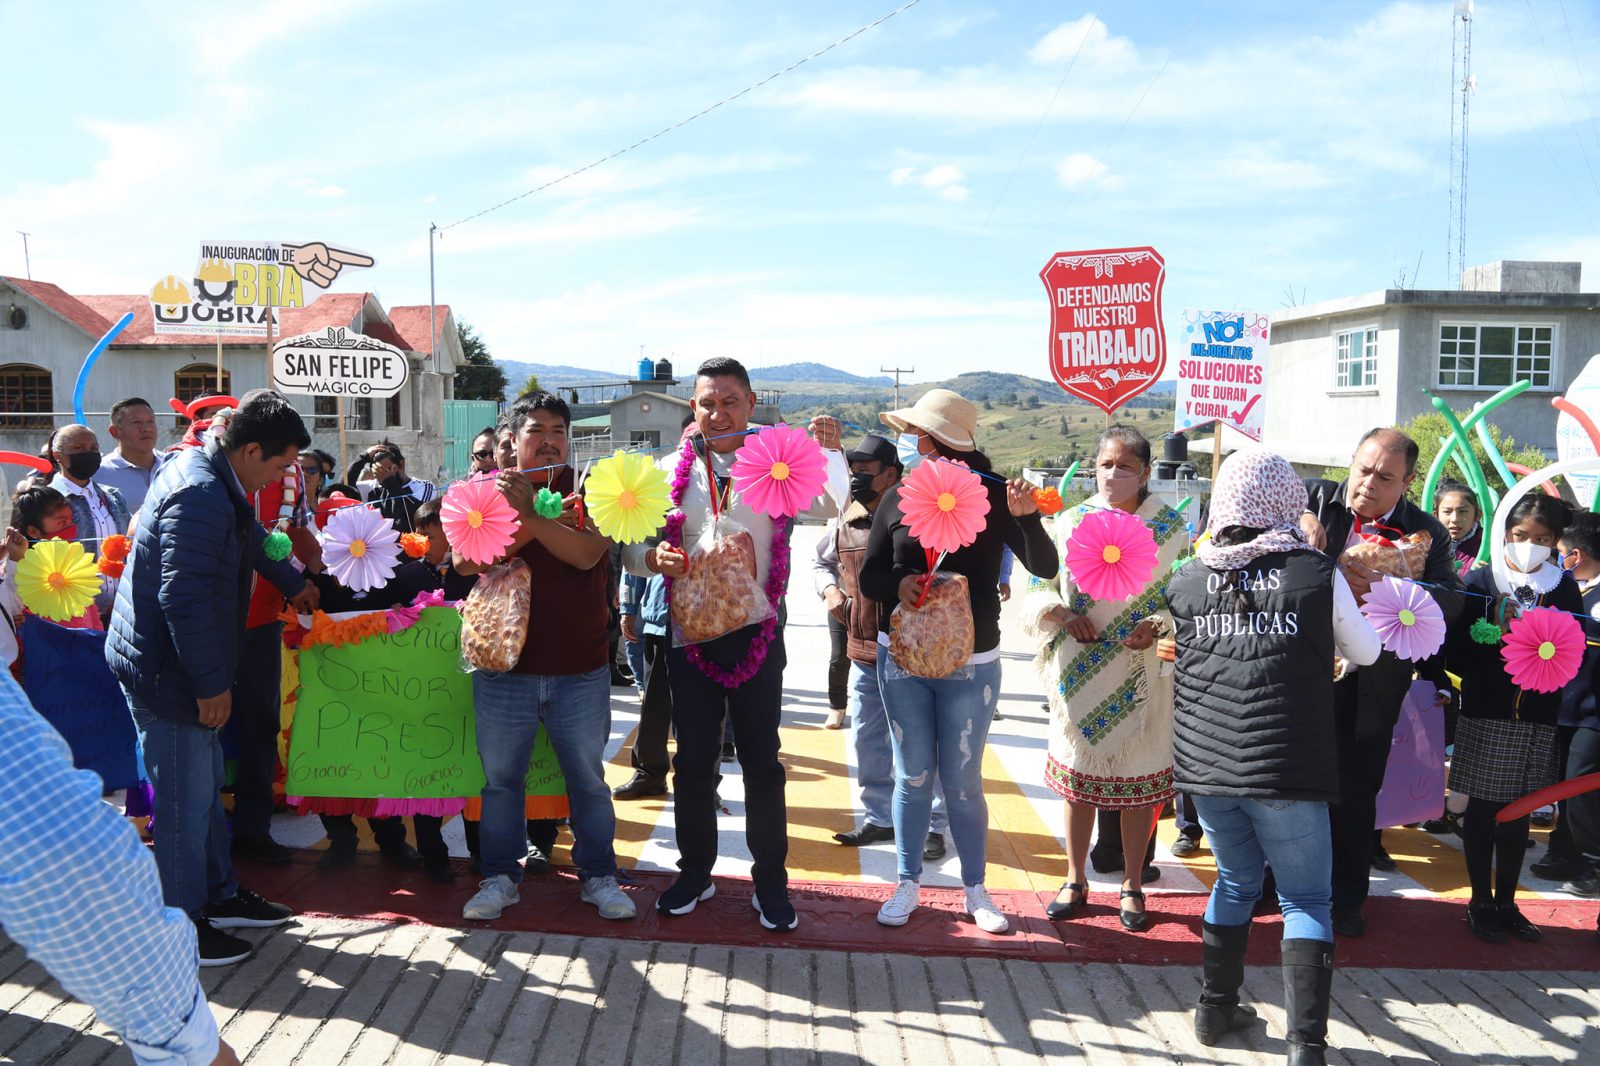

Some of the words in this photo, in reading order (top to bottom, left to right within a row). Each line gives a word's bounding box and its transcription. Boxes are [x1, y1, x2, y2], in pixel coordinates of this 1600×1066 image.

[202, 245, 279, 262] INAUGURACIÓN
[282, 249, 295, 263] DE
[1057, 282, 1152, 308] DEFENDAMOS
[1073, 305, 1137, 329] NUESTRO
[1203, 317, 1244, 343] NO!
[1058, 327, 1156, 369] TRABAJO
[1191, 343, 1253, 360] MEJORALITOS
[285, 353, 321, 377] SAN
[329, 354, 393, 380] FELIPE
[1179, 360, 1263, 385] SOLUCIONES
[307, 378, 371, 394] MÁGICO
[1191, 384, 1210, 399] QUE
[1213, 385, 1247, 402] DURAN
[1186, 401, 1192, 415] Y
[1193, 608, 1299, 639] PÚBLICAS
[316, 701, 467, 760] PRESI
[290, 752, 362, 783] Gracias
[403, 763, 464, 794] Gracias
